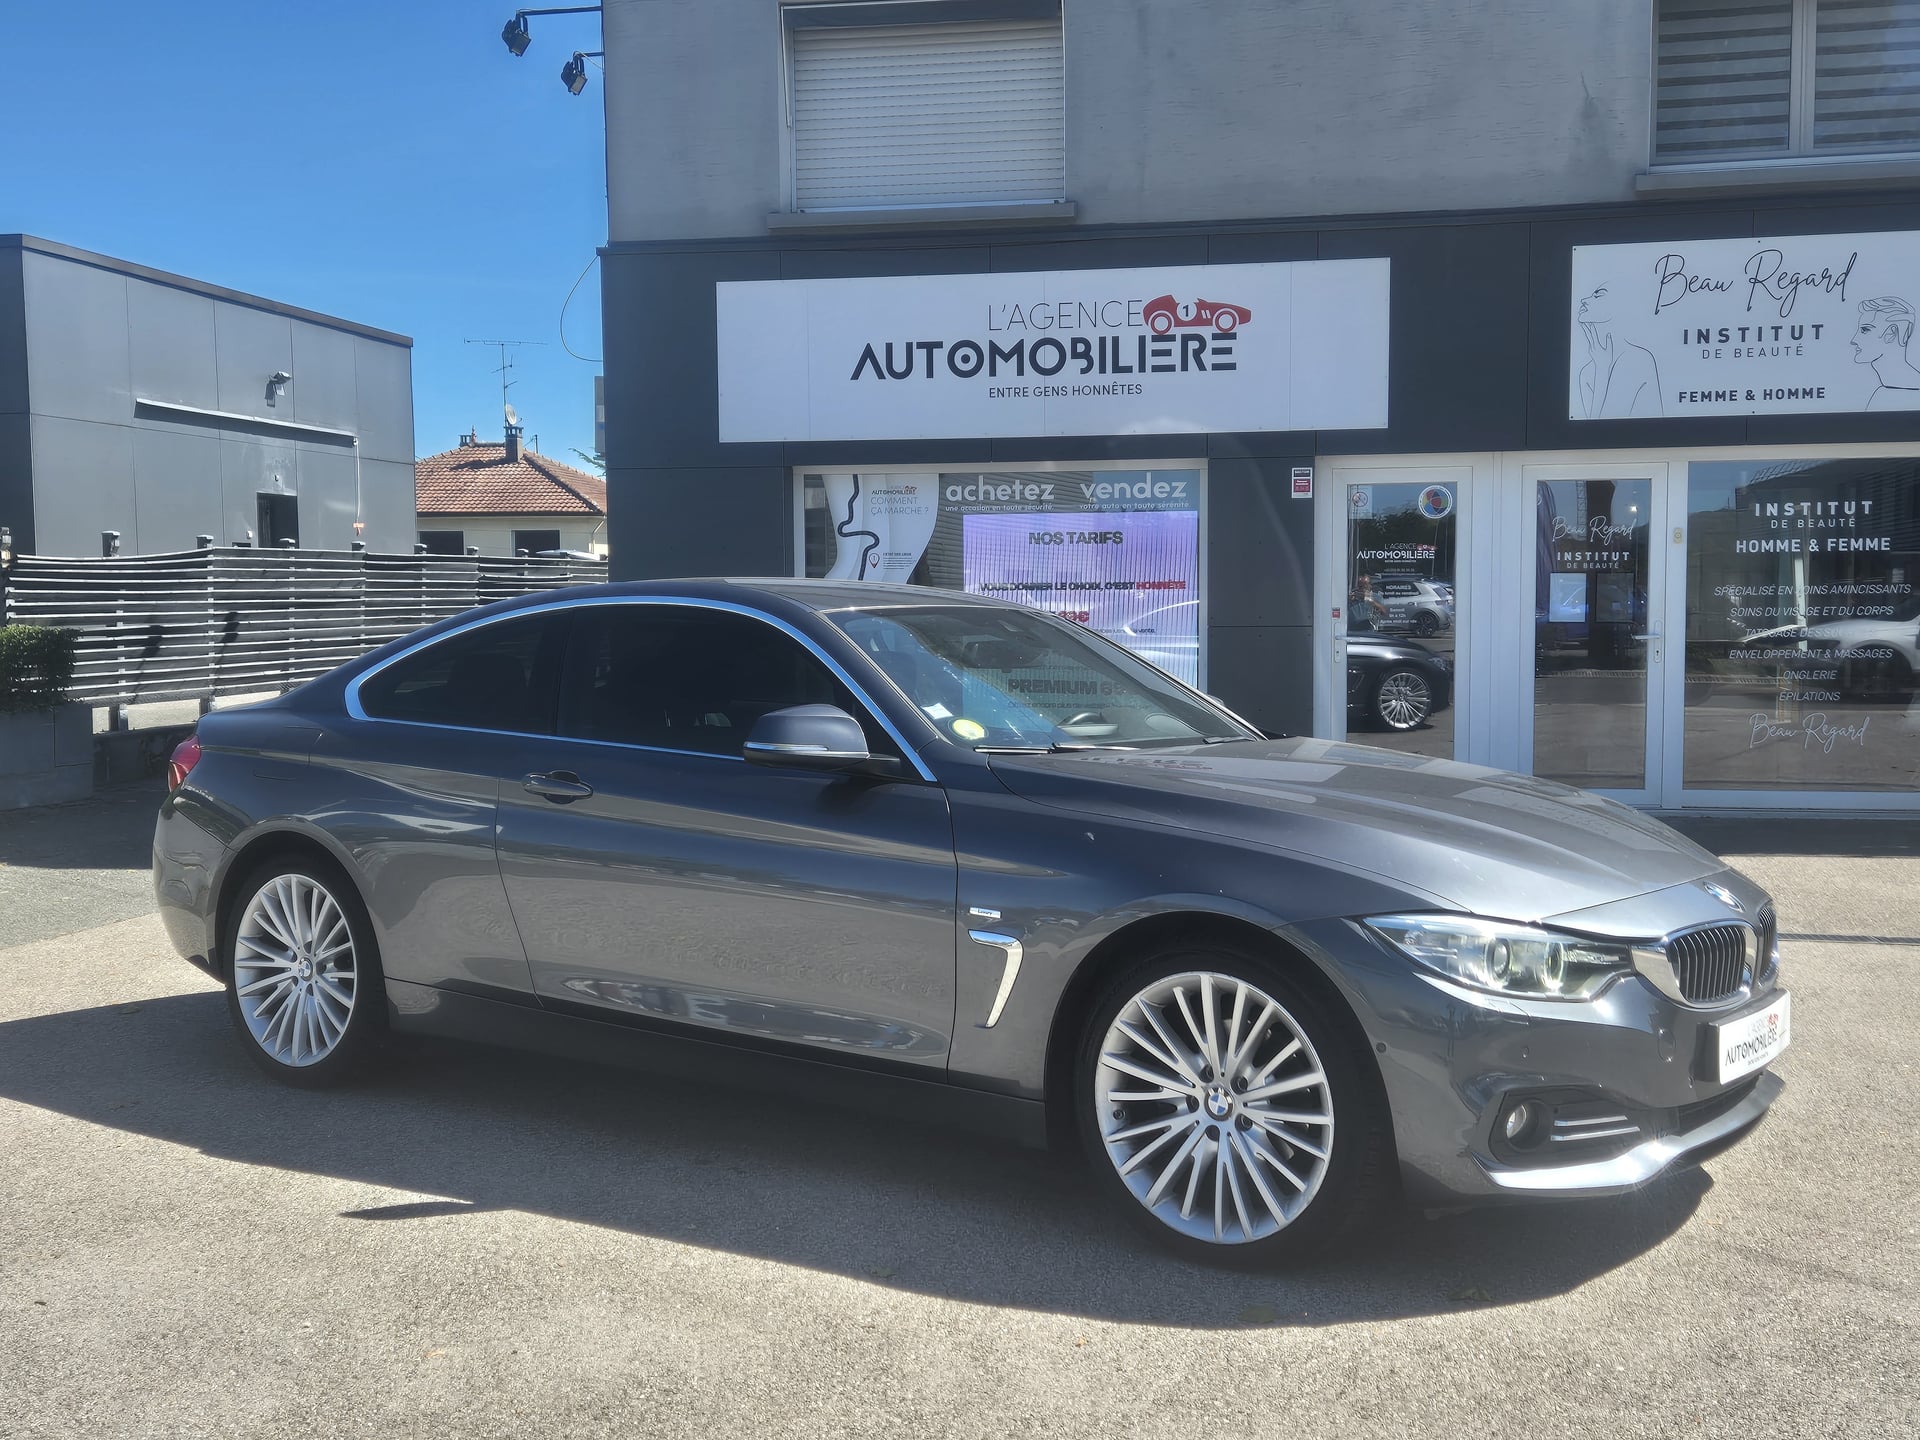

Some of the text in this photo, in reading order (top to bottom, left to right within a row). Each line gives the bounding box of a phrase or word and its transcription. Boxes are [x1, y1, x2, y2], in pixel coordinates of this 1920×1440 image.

[1655, 249, 1858, 318] Beau Regard
[988, 300, 1143, 331] L'AGENCE
[1683, 324, 1824, 344] INSTITUT
[1702, 343, 1803, 359] DE BEAUTÉ
[989, 381, 1143, 398] ENTRE GENS HONNÊTES
[1679, 387, 1825, 403] FEMME & HOMME
[945, 475, 1055, 501] achetez
[1080, 472, 1187, 499] vendez
[871, 496, 918, 505] COMMENT
[960, 504, 989, 512] occasion
[1003, 503, 1021, 511] toute
[1134, 501, 1155, 509] toute
[871, 506, 883, 517] ÇA
[885, 506, 922, 515] MARCHE
[1755, 501, 1872, 516] INSTITUT
[1771, 515, 1855, 528] DE BEAUTÉ
[1029, 530, 1123, 545] NOS TARIFS
[1552, 516, 1637, 546] Beau Regard
[1736, 537, 1891, 552] HOMME & FEMME
[1557, 551, 1630, 561] INSTITUT
[1583, 561, 1619, 569] BEAUTÉ
[1055, 582, 1067, 590] LE
[1714, 584, 1911, 596] SPÉCIALISÉ EN OINS AMINCISSANTS
[1730, 606, 1894, 616] SOINS DU VISGE ET DU CORPS
[1729, 649, 1893, 659] ENVELOPPEMENT & MASSAGES
[1783, 670, 1838, 680] ONGLERIE
[1008, 679, 1098, 695] PREMIUM
[1750, 712, 1870, 753] Beau Regard
